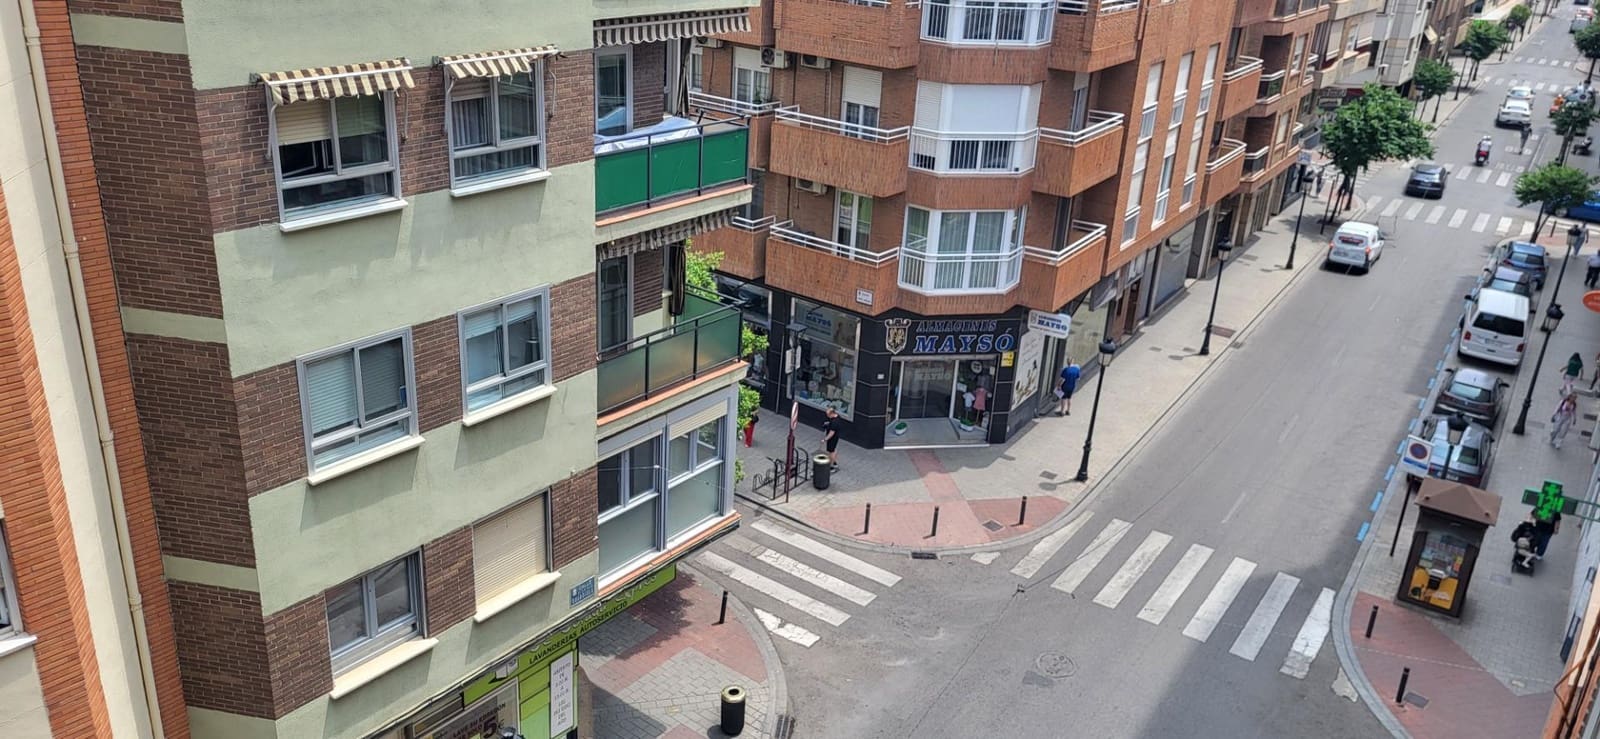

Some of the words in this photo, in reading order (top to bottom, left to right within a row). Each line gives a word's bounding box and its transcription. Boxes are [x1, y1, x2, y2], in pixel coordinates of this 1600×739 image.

[916, 319, 998, 333] ALMACENES
[912, 328, 1015, 354] MAYSÓ
[580, 600, 628, 633] AUTOSERVICIO
[483, 715, 497, 739] 5
